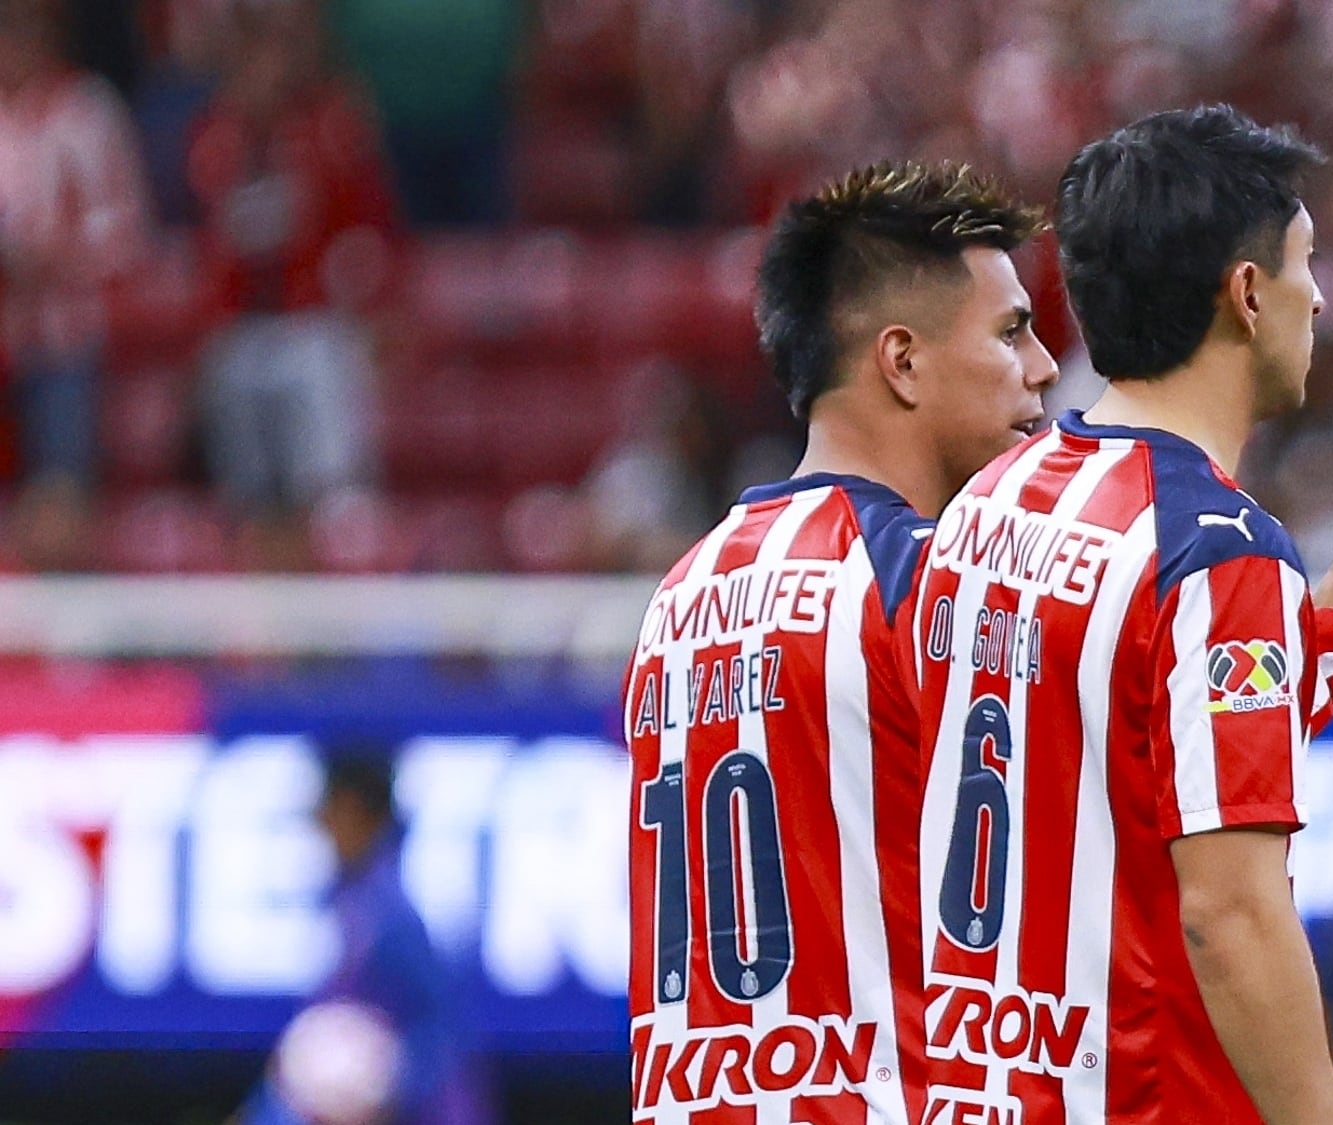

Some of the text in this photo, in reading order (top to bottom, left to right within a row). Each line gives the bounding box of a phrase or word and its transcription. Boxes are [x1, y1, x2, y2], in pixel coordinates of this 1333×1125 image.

[937, 505, 1105, 594] OMNILIFE
[643, 570, 828, 650] OMNILIFE
[927, 596, 1042, 685] O. GOVEA
[634, 645, 785, 737] ALVAREZ
[1233, 696, 1274, 711] BBVA
[937, 694, 1012, 950] 6
[641, 749, 795, 1004] 10
